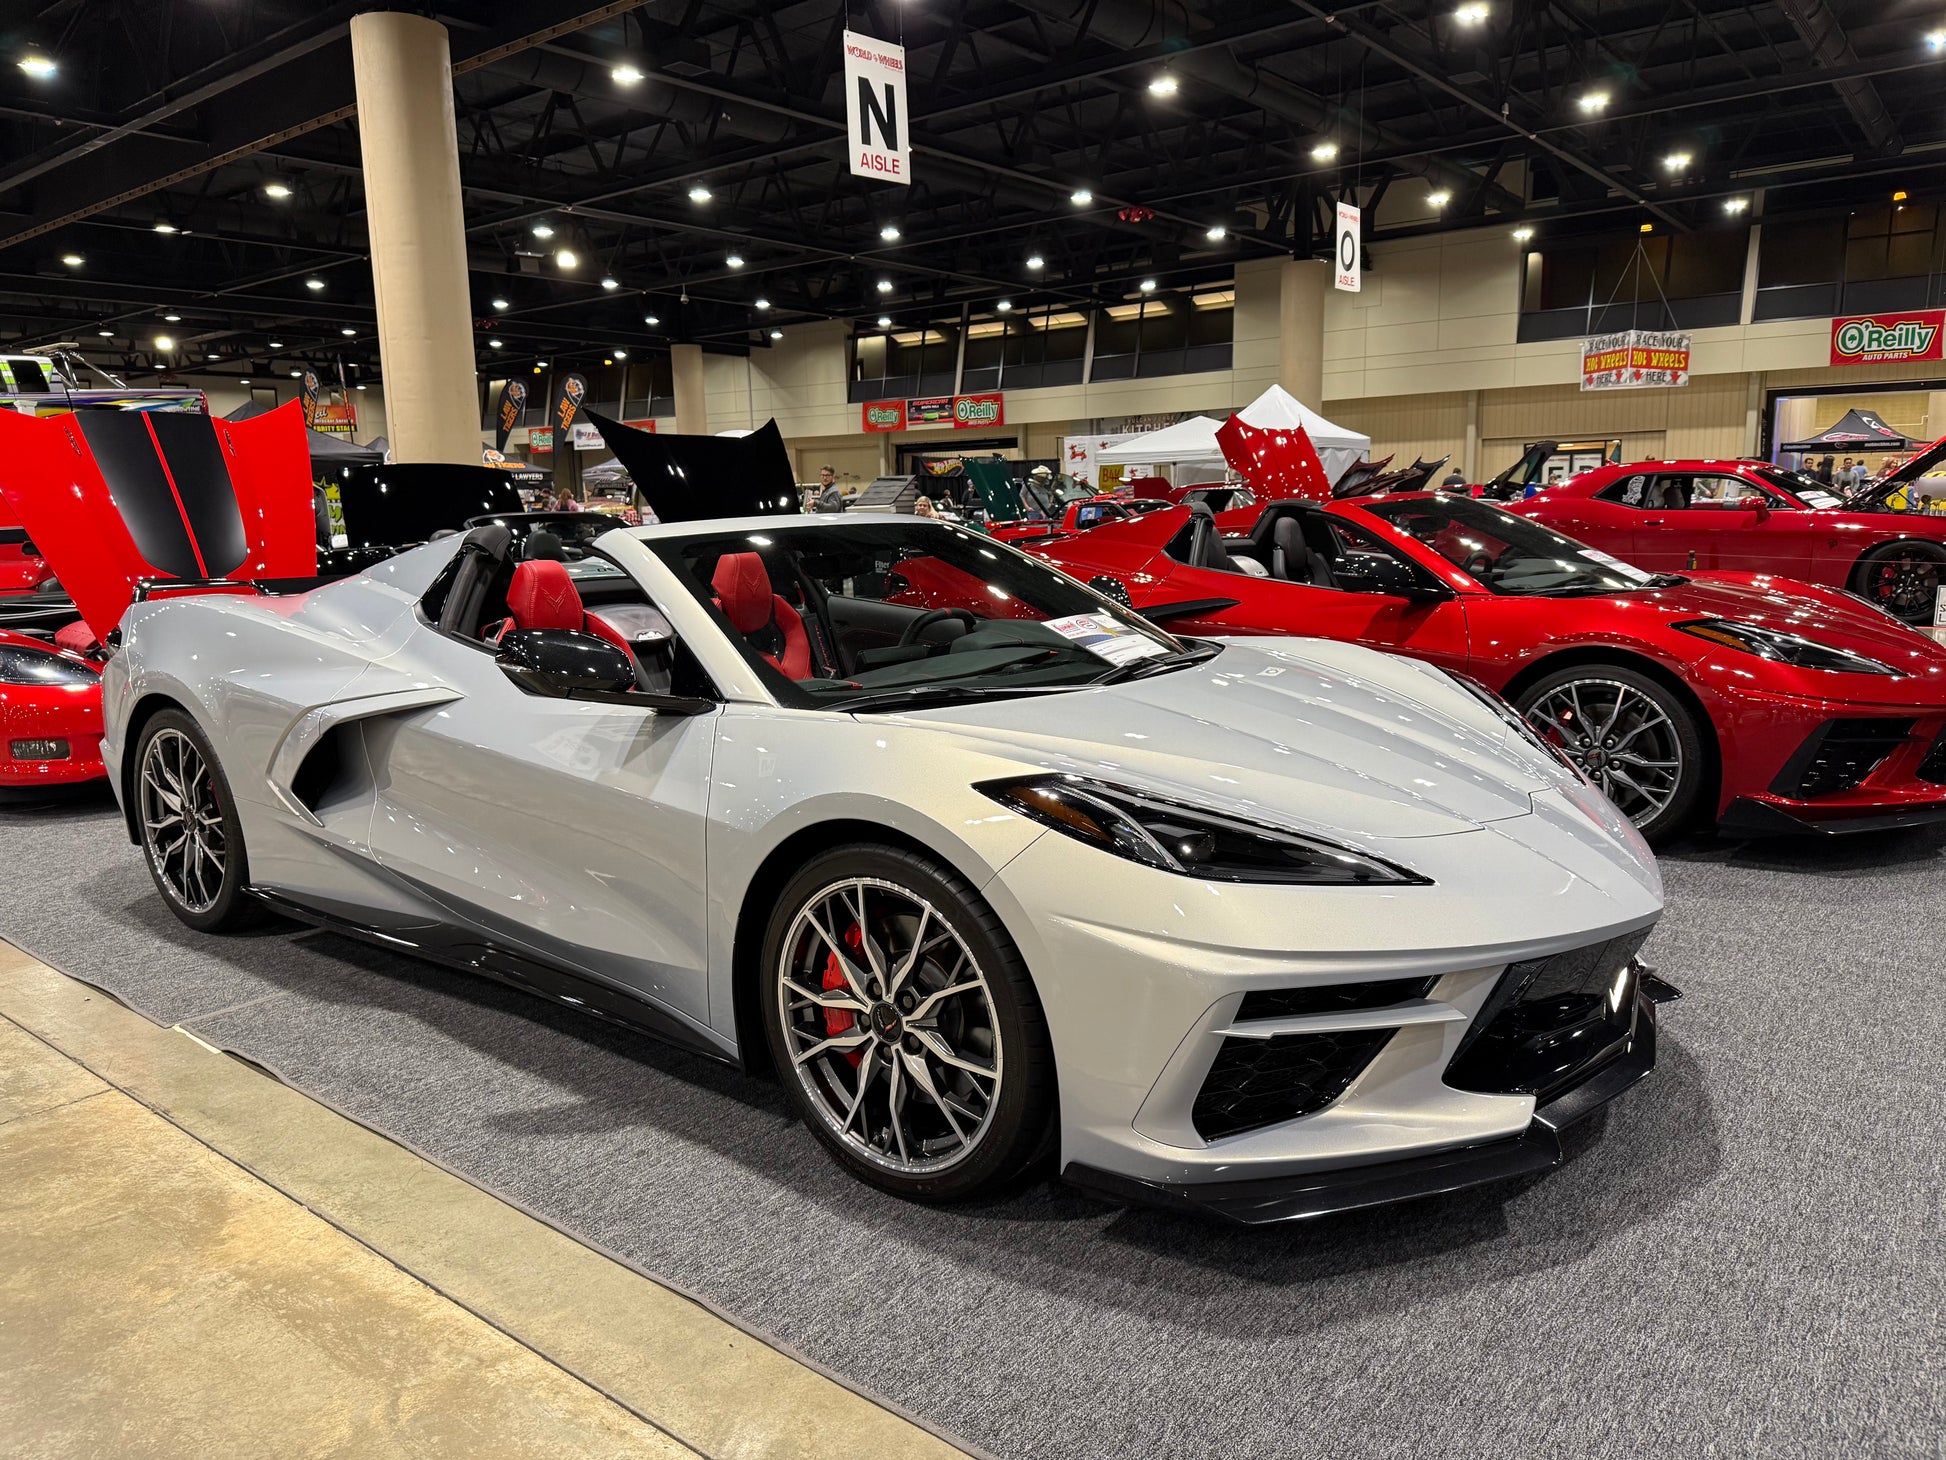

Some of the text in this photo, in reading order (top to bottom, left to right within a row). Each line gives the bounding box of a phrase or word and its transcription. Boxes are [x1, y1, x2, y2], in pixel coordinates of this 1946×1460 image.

[858, 76, 898, 152] N
[860, 153, 900, 174] AISLE
[1339, 275, 1355, 287] AISLE
[1589, 335, 1627, 351] RACE YOUR
[1636, 334, 1683, 348] RACE YOUR
[1839, 322, 1933, 352] O'Reilly
[1883, 352, 1908, 360] PARTS
[1596, 372, 1613, 384] HERE
[1646, 371, 1667, 382] HERE
[500, 400, 513, 420] LAW
[557, 397, 570, 418] LAW
[869, 408, 898, 424] O'Reilly
[957, 400, 998, 419] O'Reilly
[503, 407, 519, 432] TIGERS
[560, 404, 577, 431] TIGERS
